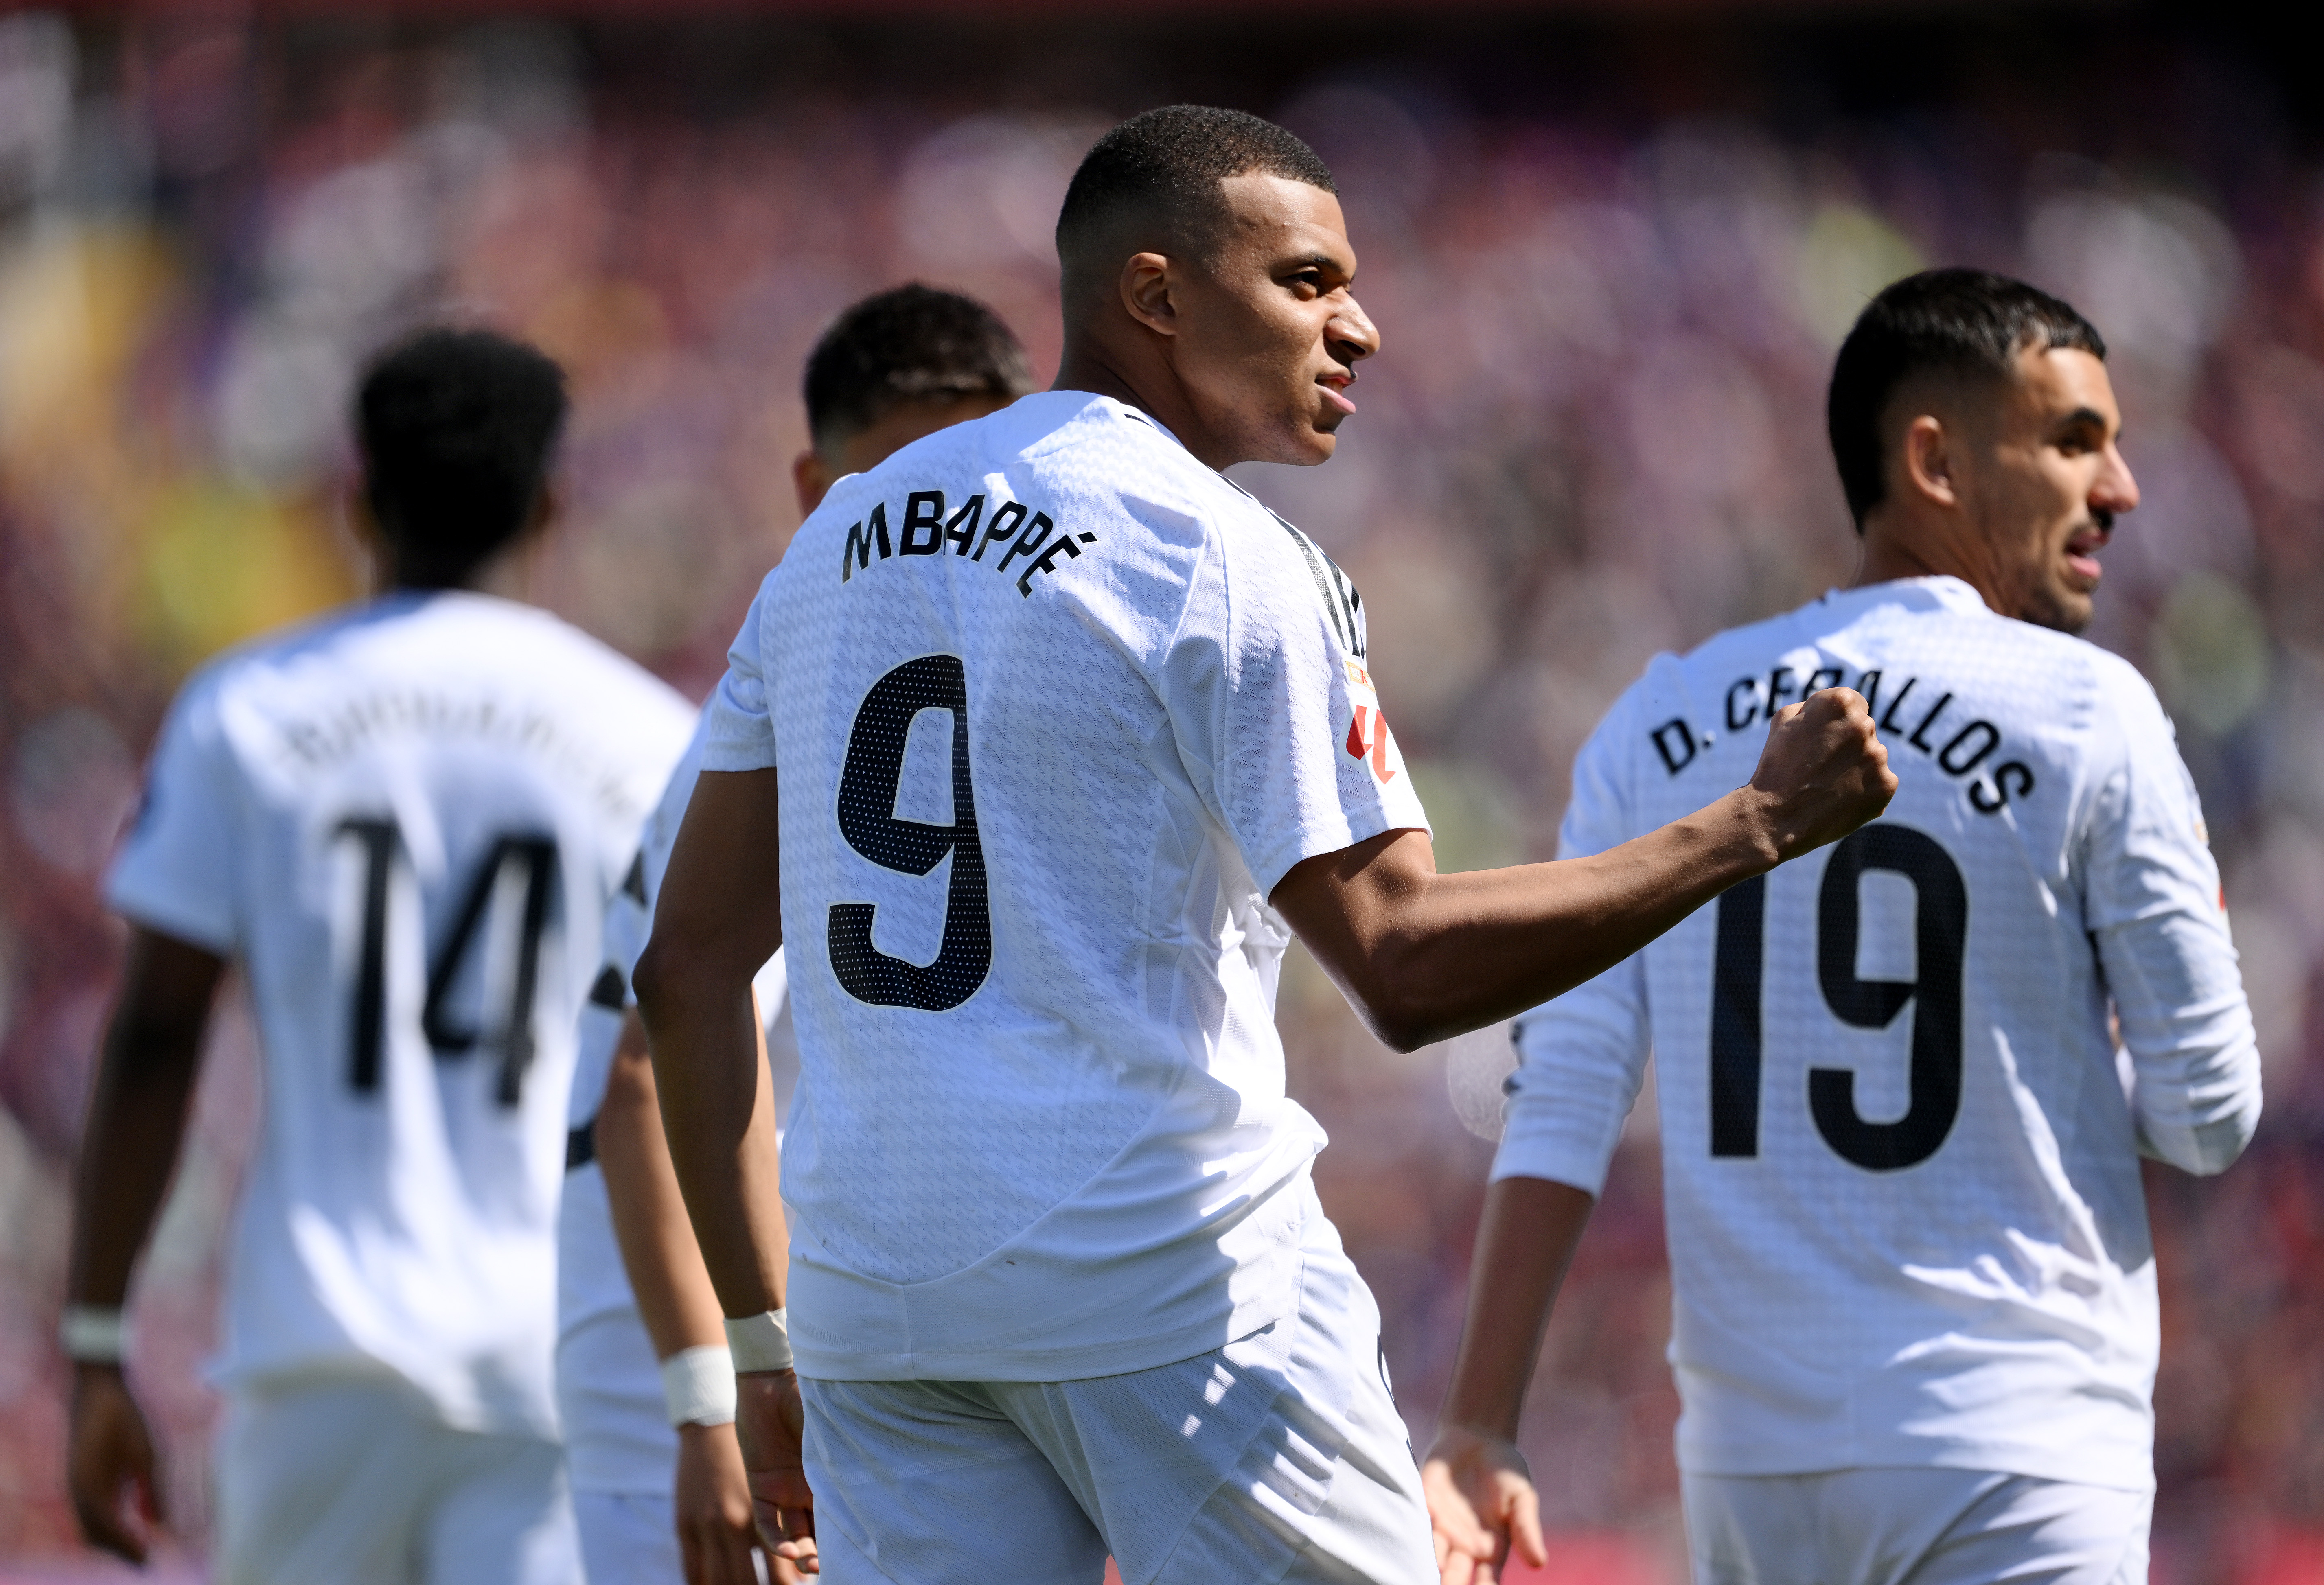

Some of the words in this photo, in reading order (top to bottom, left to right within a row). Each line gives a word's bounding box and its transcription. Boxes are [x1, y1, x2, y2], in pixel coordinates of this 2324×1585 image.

[841, 490, 1098, 599] MBAPPÉ
[827, 654, 993, 1012] 9
[1650, 718, 1712, 777] D.
[330, 815, 561, 1109] 14
[1710, 822, 1969, 1173] 19
